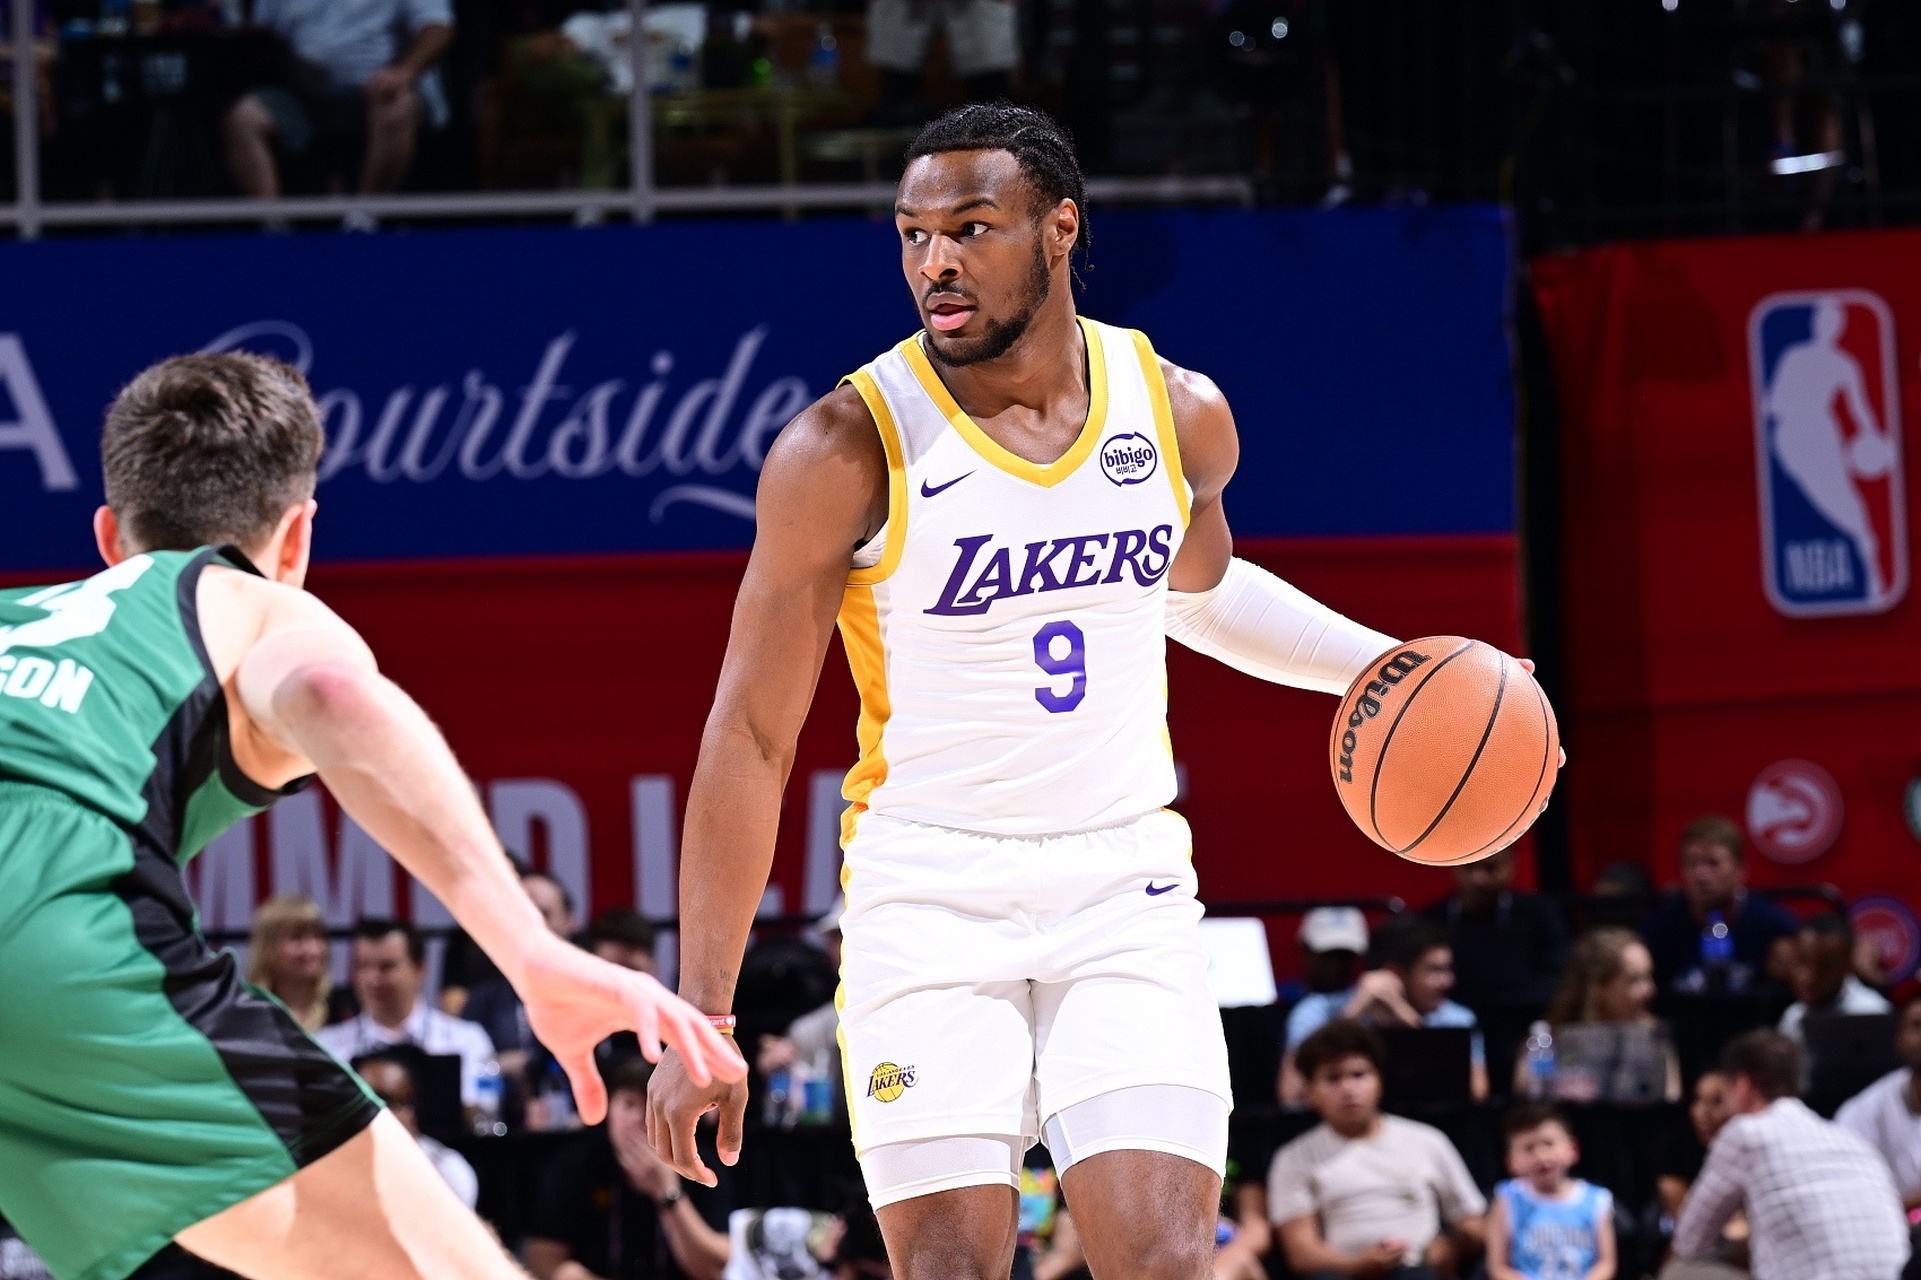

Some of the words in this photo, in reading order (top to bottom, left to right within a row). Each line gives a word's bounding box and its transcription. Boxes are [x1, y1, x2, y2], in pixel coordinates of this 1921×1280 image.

[1104, 446, 1153, 468] bibigo
[923, 524, 1172, 616] LAKERS
[1784, 539, 1855, 592] NBA
[1033, 620, 1087, 713] 9
[1339, 650, 1432, 784] Wilson
[866, 1071, 919, 1098] LAKERS
